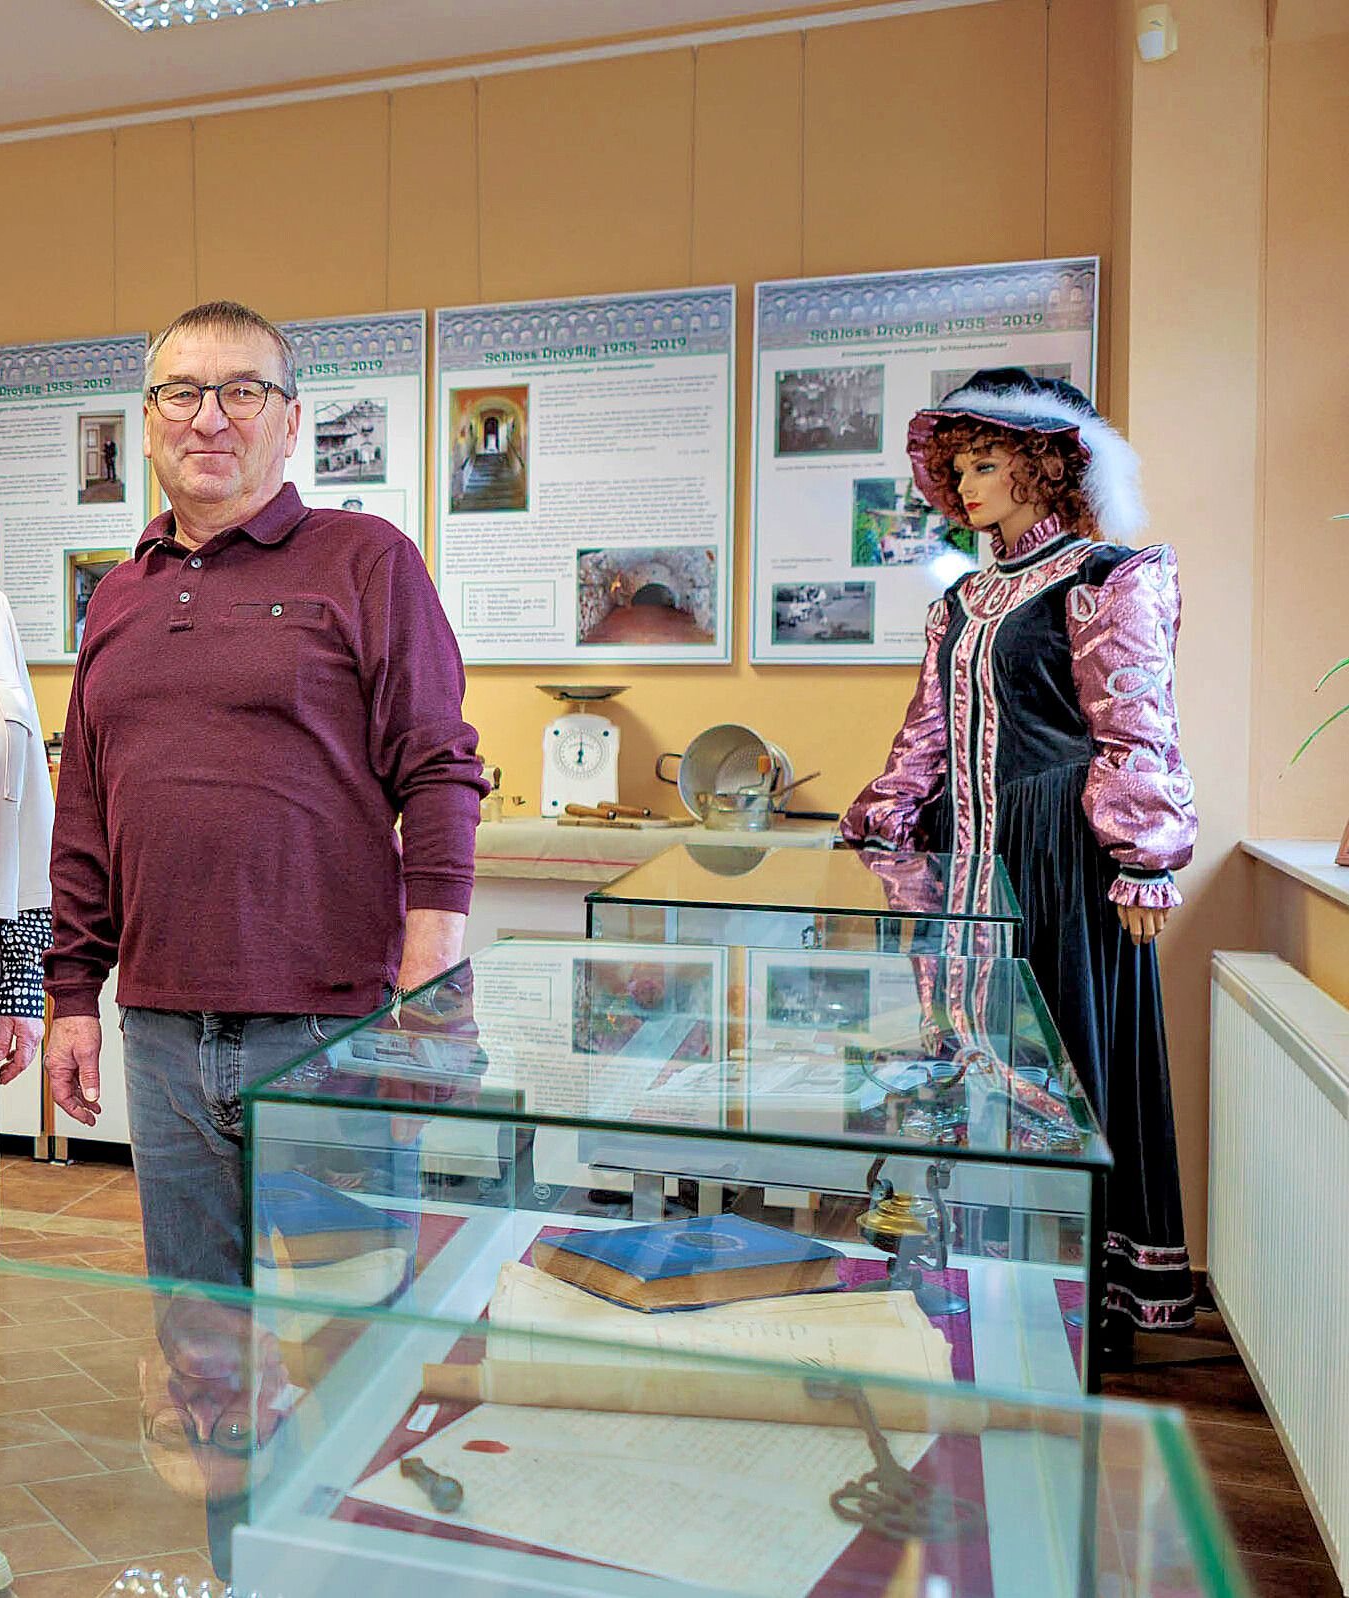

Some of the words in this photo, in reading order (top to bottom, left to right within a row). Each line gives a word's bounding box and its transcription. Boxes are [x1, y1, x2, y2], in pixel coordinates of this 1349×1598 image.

[810, 326, 871, 341] Schloss
[876, 320, 938, 338] Droyßig
[1003, 312, 1043, 327] 2019
[484, 350, 537, 364] Schloss
[542, 344, 597, 359] Droyßig
[651, 336, 687, 350] 2019
[308, 363, 339, 375] 1955
[350, 360, 383, 371] 2019
[83, 377, 111, 390] 2019
